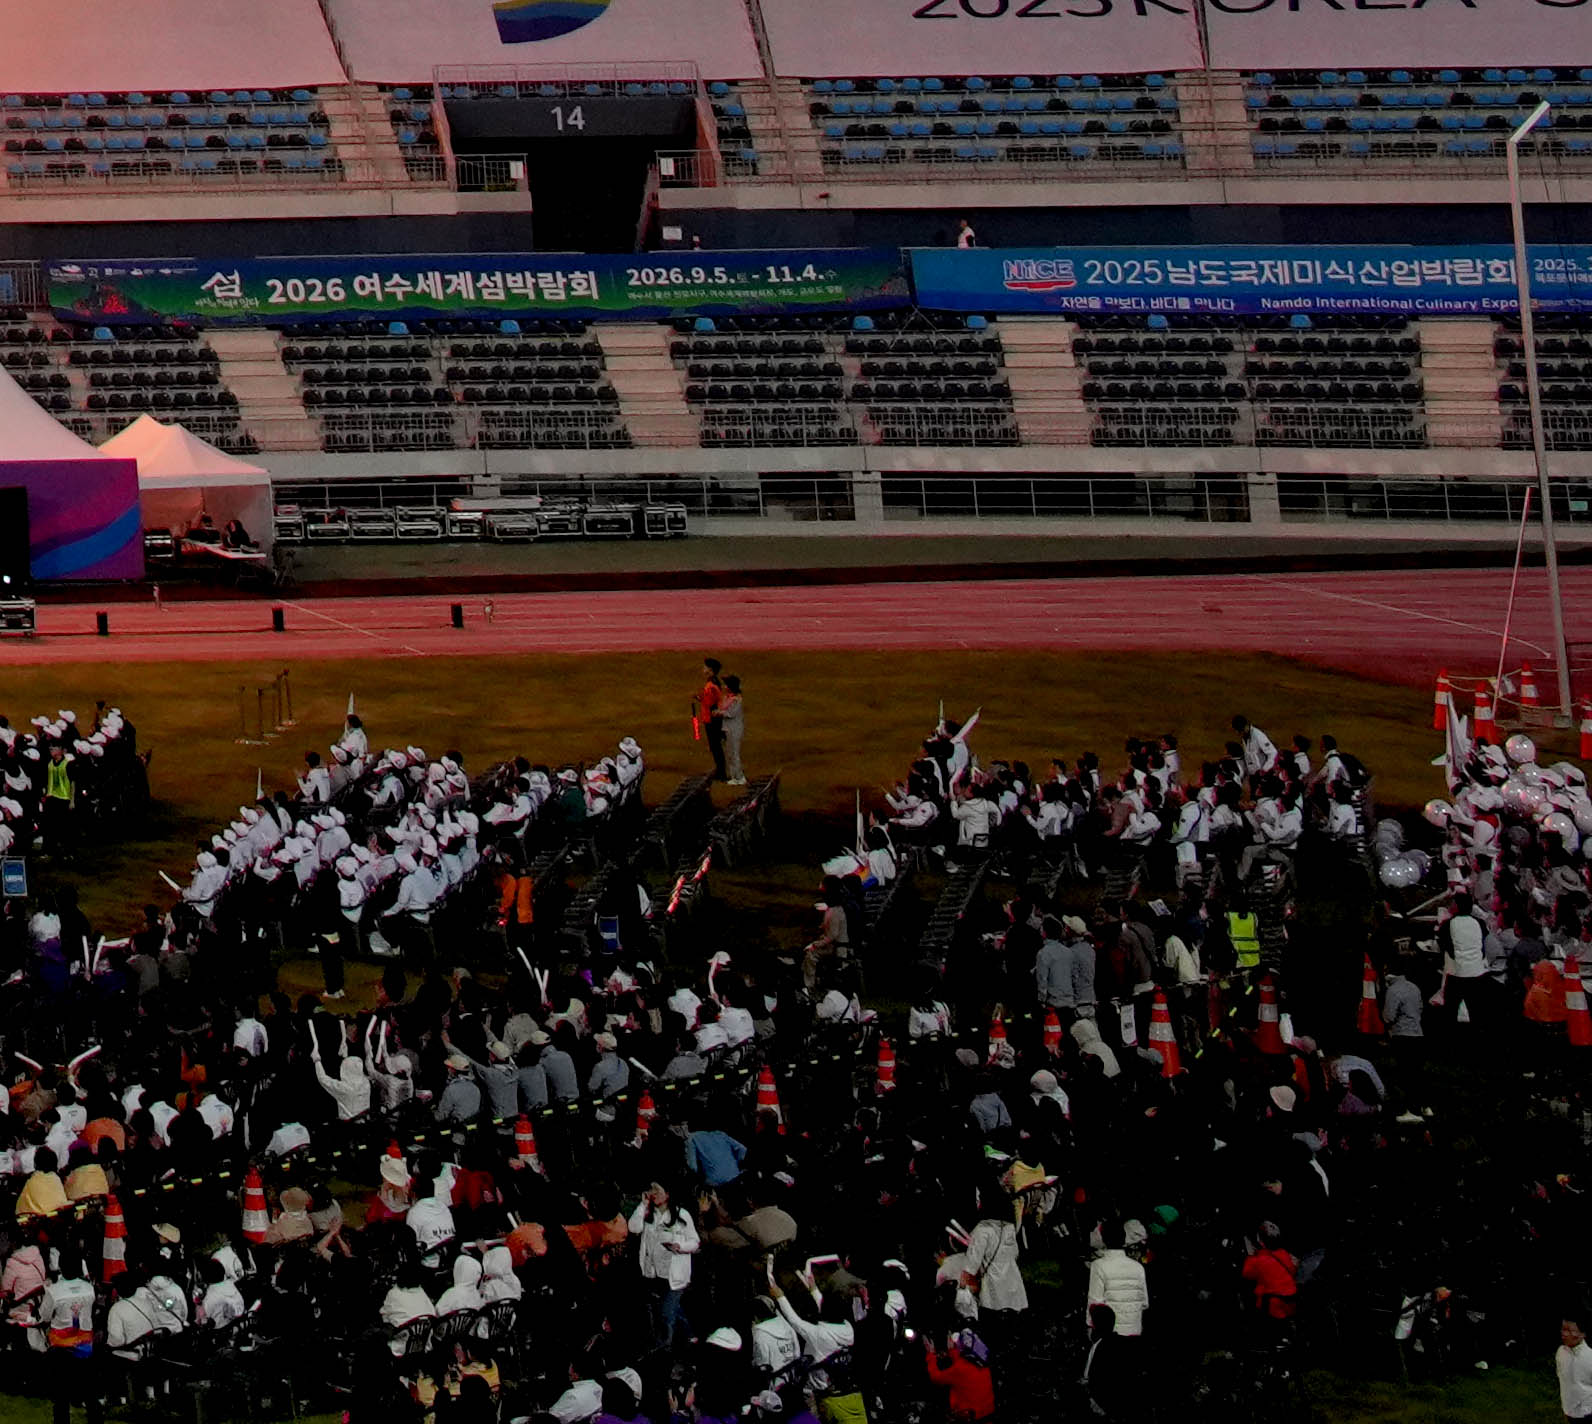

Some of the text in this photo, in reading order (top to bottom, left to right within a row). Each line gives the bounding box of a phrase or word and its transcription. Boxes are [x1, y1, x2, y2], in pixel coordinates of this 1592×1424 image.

[551, 105, 585, 131] 14
[200, 269, 242, 298] 섬
[267, 268, 599, 305] 2026 여수세계섬박람회
[1261, 296, 1311, 309] Namdo
[1316, 297, 1412, 309] International
[1415, 298, 1477, 311] Culinary
[1482, 297, 1518, 310] Expo
